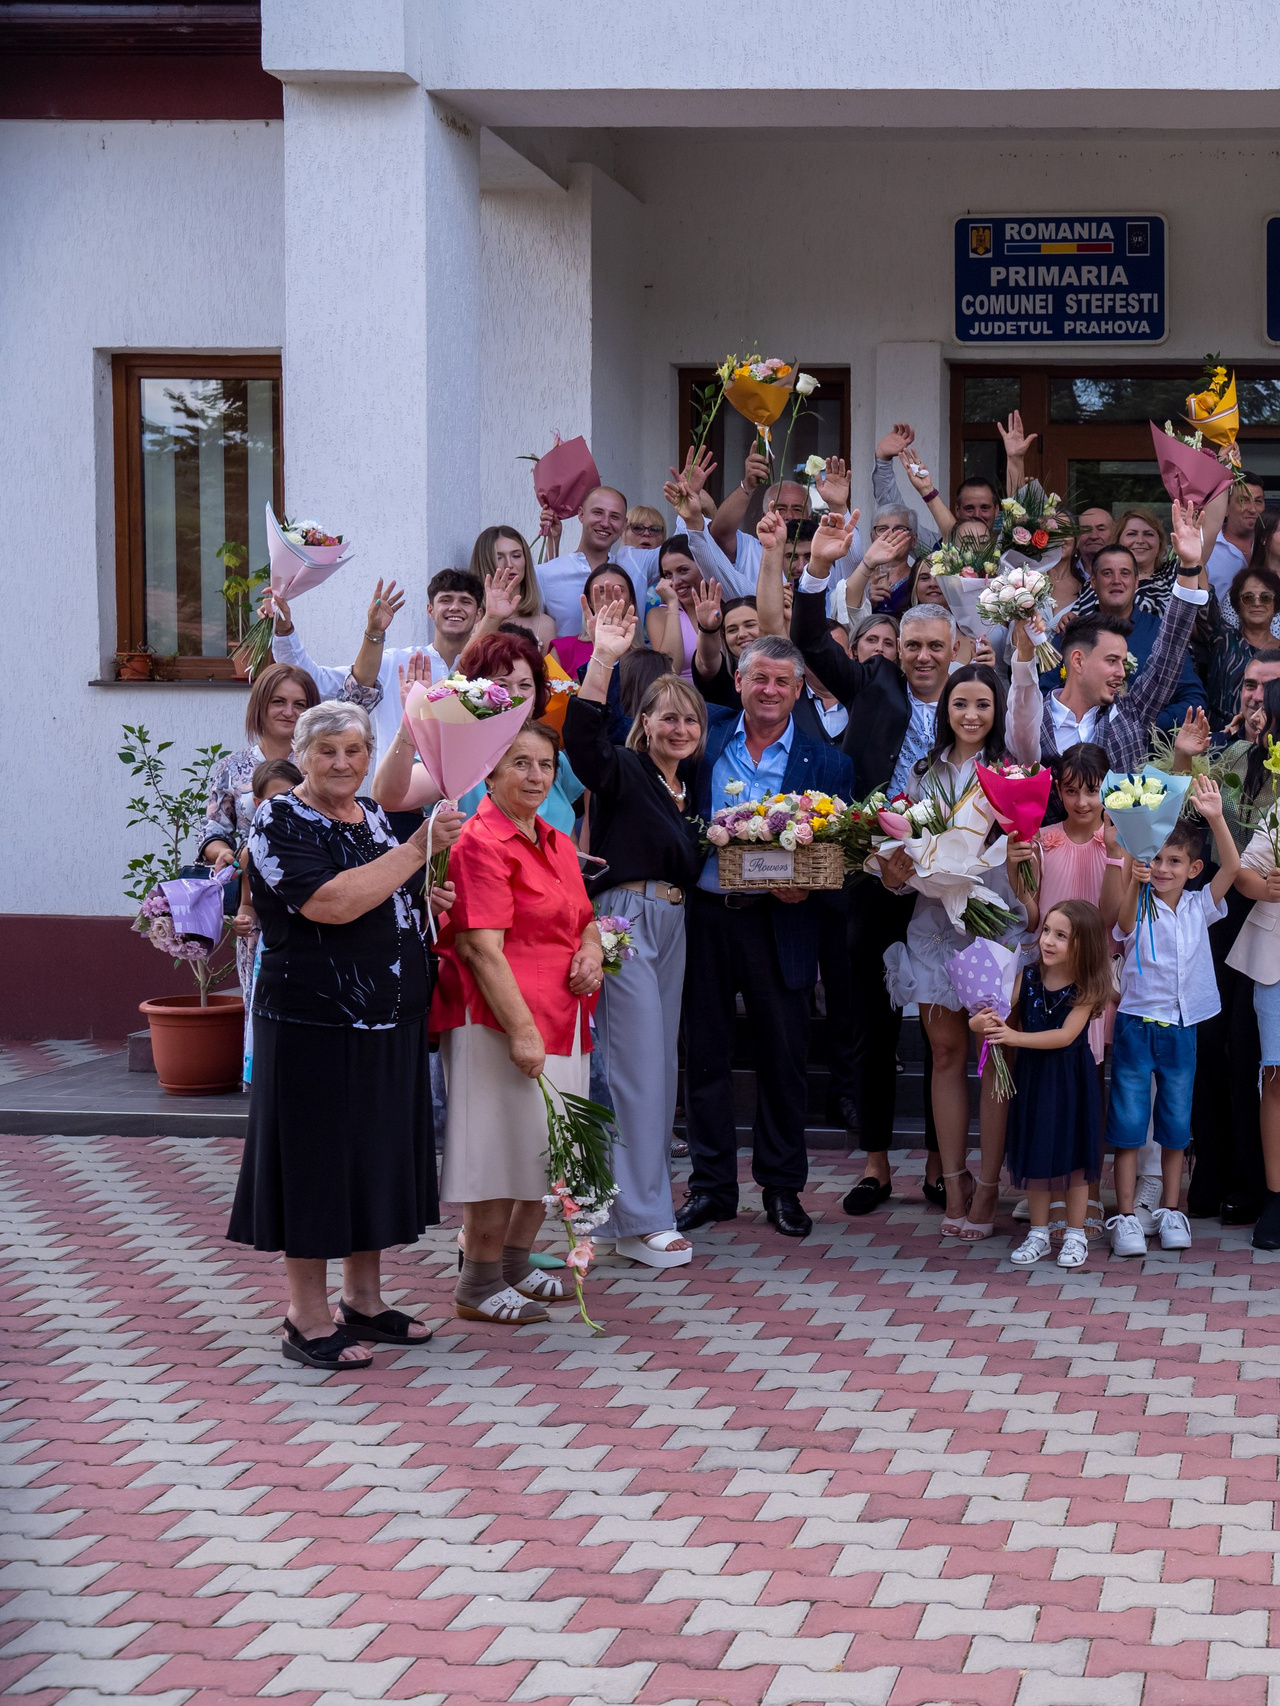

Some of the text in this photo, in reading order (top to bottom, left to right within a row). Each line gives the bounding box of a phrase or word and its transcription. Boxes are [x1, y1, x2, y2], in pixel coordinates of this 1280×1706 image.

[1004, 221, 1115, 241] ROMANIA
[990, 265, 1129, 287] PRIMARIA
[961, 292, 1159, 315] COMUNEI STEFESTI
[968, 320, 1151, 336] JUDETUL PRAHOVA
[748, 857, 788, 873] Flowers
